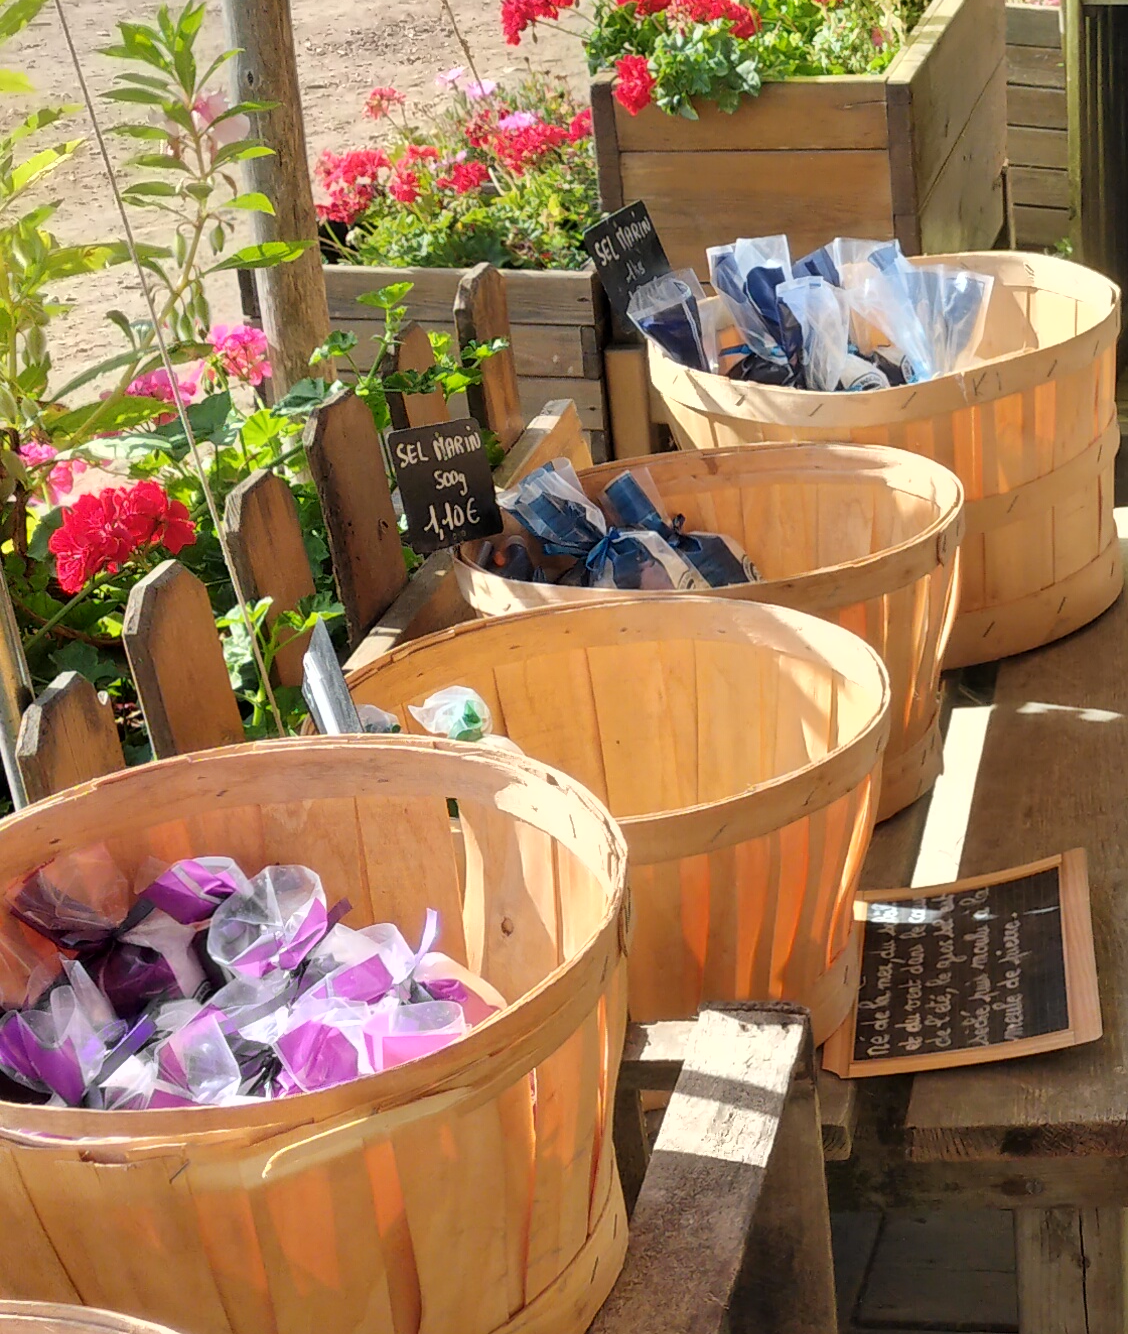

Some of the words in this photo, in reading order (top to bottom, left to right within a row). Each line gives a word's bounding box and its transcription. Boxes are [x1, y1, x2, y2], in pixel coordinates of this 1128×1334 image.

[594, 235, 620, 267] SEL
[396, 441, 429, 469] SEL
[433, 470, 468, 497] 500g
[960, 888, 990, 905] la
[899, 925, 925, 939] le
[871, 939, 894, 958] du
[936, 939, 966, 969] gros
[900, 944, 924, 974] dans
[926, 973, 951, 985] le
[997, 969, 1020, 989] de
[860, 991, 891, 1009] la
[898, 979, 923, 1011] vent
[861, 1011, 889, 1030] de
[895, 1014, 922, 1032] du
[860, 1035, 891, 1056] né
[898, 1037, 923, 1050] et
[927, 1028, 951, 1047] de
